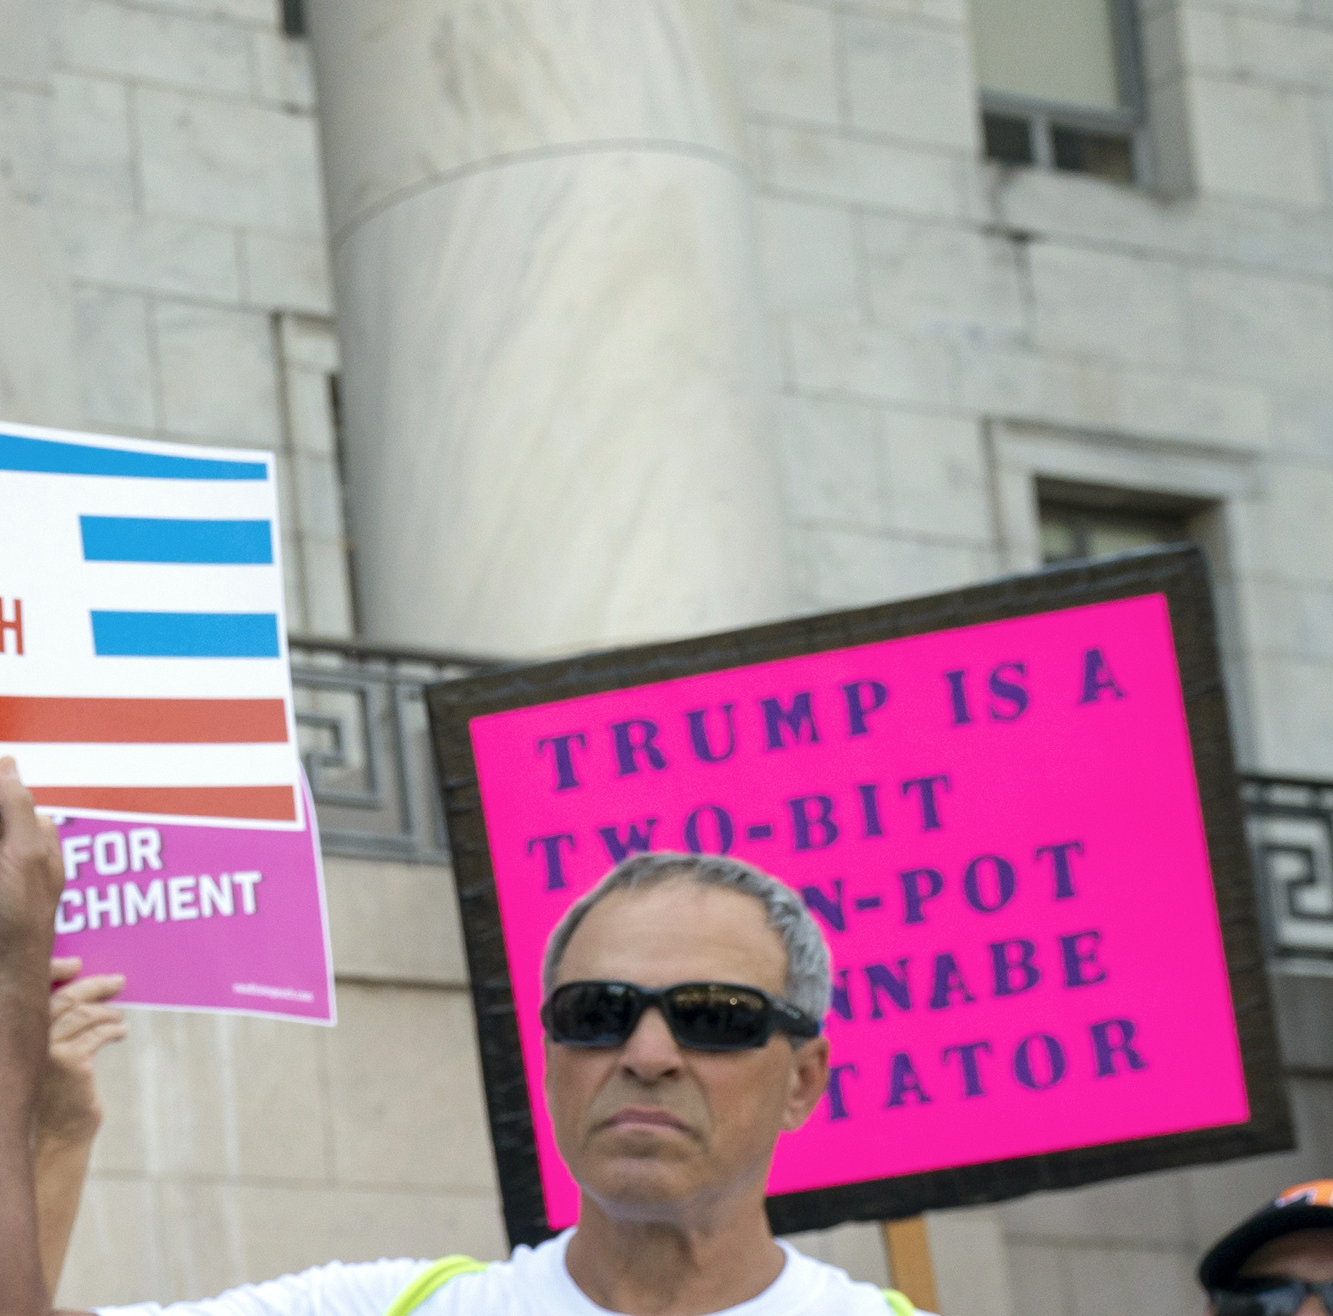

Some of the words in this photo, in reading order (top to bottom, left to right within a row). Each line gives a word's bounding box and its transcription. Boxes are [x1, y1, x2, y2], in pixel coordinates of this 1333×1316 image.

[538, 680, 891, 793] TRUMP
[945, 662, 1031, 726] IS
[1076, 648, 1129, 704] A
[61, 826, 164, 881] FOR
[527, 773, 953, 892] TWO-BIT
[827, 1018, 1150, 1122] TATOR
